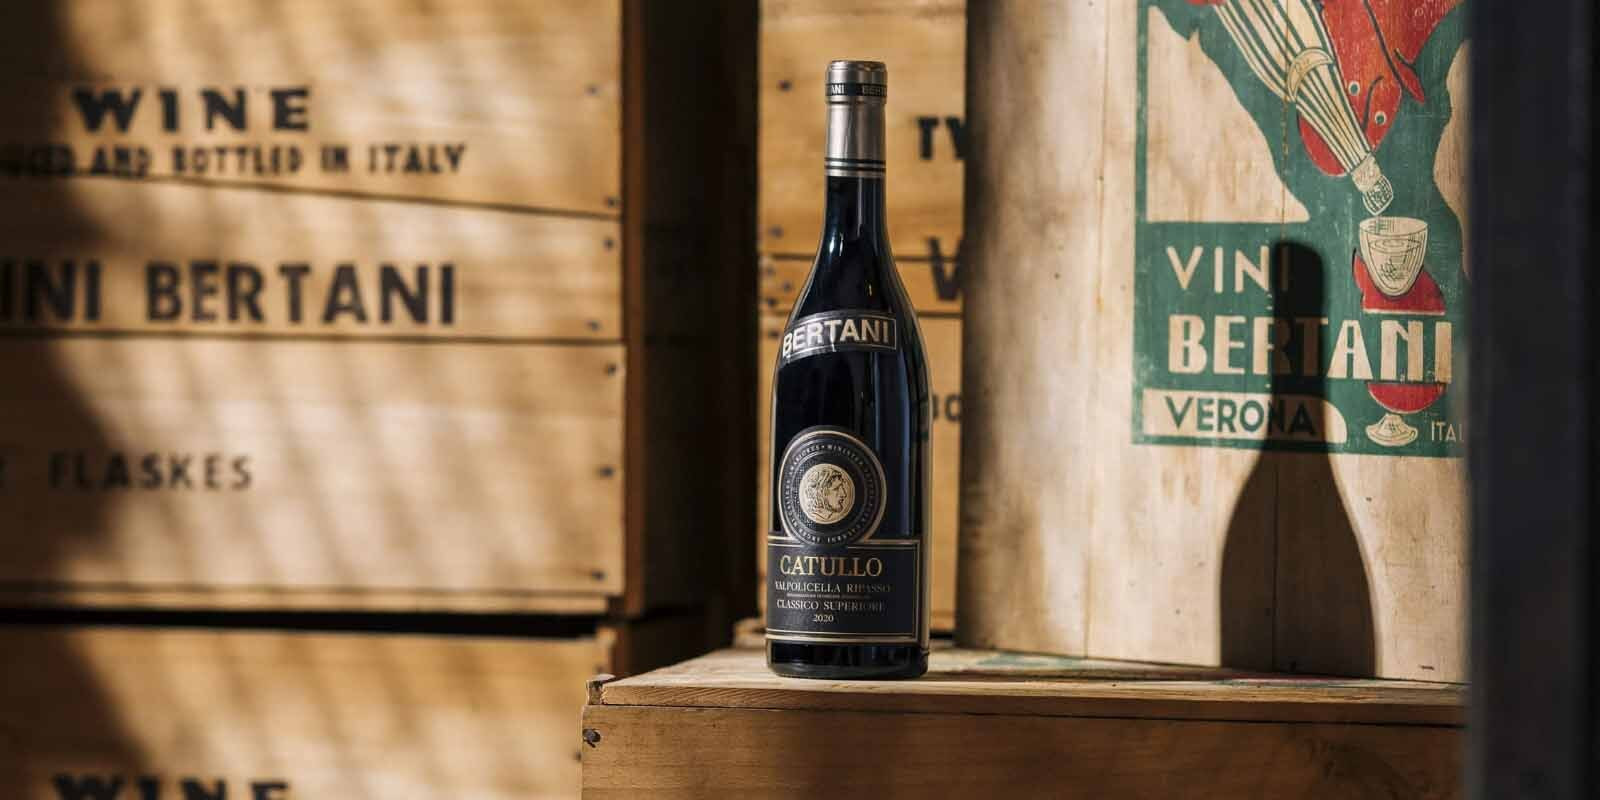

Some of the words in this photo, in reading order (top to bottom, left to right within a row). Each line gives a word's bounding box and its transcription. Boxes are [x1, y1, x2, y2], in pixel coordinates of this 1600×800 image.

[72, 87, 311, 132] WINE
[171, 143, 304, 175] BOTTLED
[320, 145, 350, 174] IN
[367, 143, 467, 174] ITALY
[1166, 245, 1290, 294] VINI
[145, 259, 457, 325] BERTANI
[782, 318, 889, 360] BERTANI
[1167, 315, 1453, 384] BERTANI
[1164, 394, 1318, 438] VERONA
[51, 453, 253, 491] FLASKES
[779, 554, 883, 577] CATULLO
[775, 580, 841, 593] VALPOLICELLA
[776, 599, 819, 611] CLASSICO
[812, 613, 835, 623] 2020
